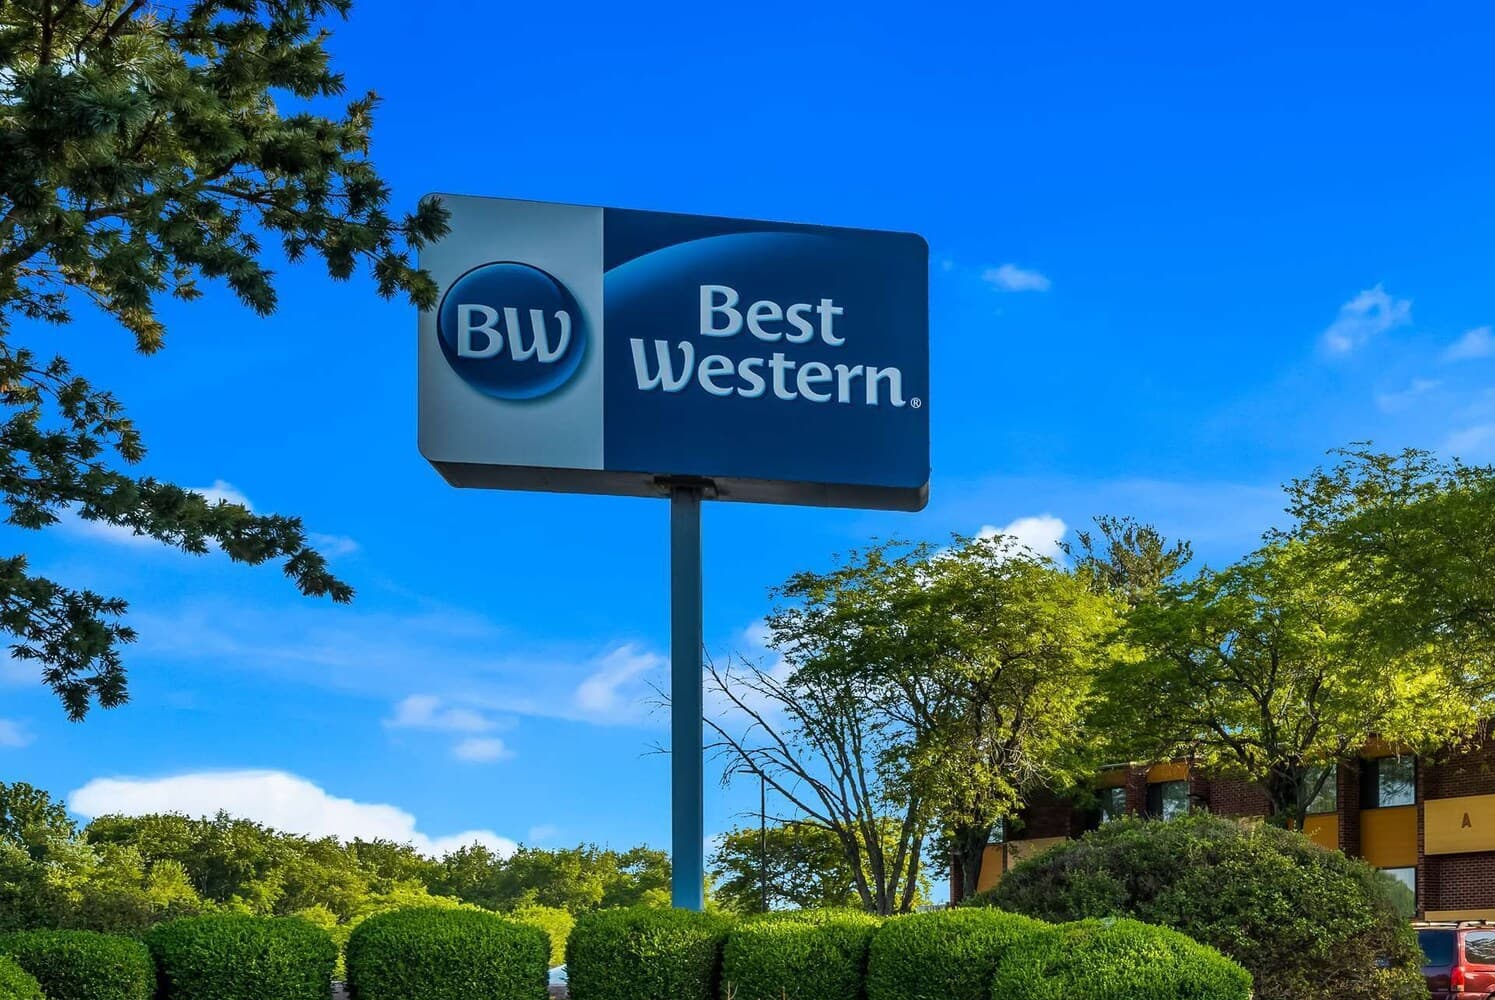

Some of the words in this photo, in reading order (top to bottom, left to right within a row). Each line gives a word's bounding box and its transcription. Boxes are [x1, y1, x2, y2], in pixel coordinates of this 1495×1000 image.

[457, 303, 572, 364] BW
[699, 284, 846, 347] Best
[1461, 812, 1472, 829] A
